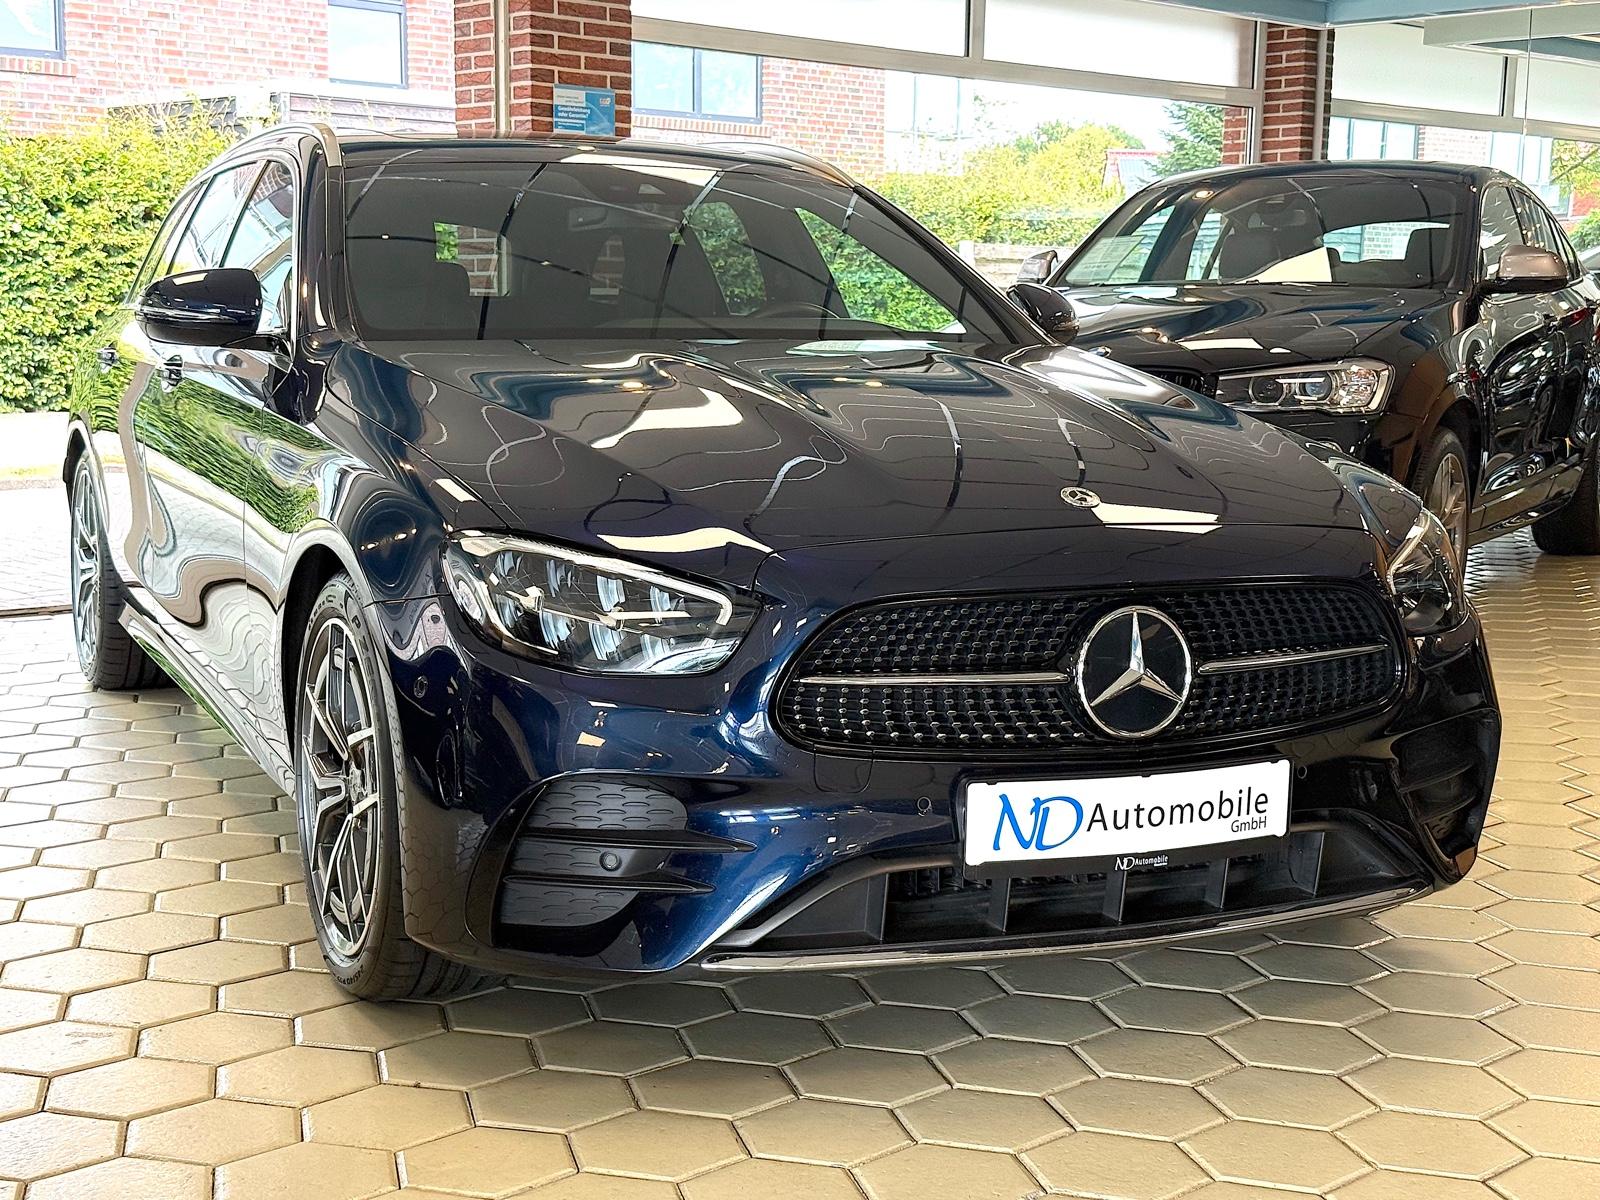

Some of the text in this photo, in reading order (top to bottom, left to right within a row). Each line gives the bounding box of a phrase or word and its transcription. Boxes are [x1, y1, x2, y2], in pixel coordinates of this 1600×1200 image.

[992, 786, 1269, 851] ND Automobile
[1230, 816, 1268, 833] GmbH
[1114, 854, 1169, 871] ND Automobile
